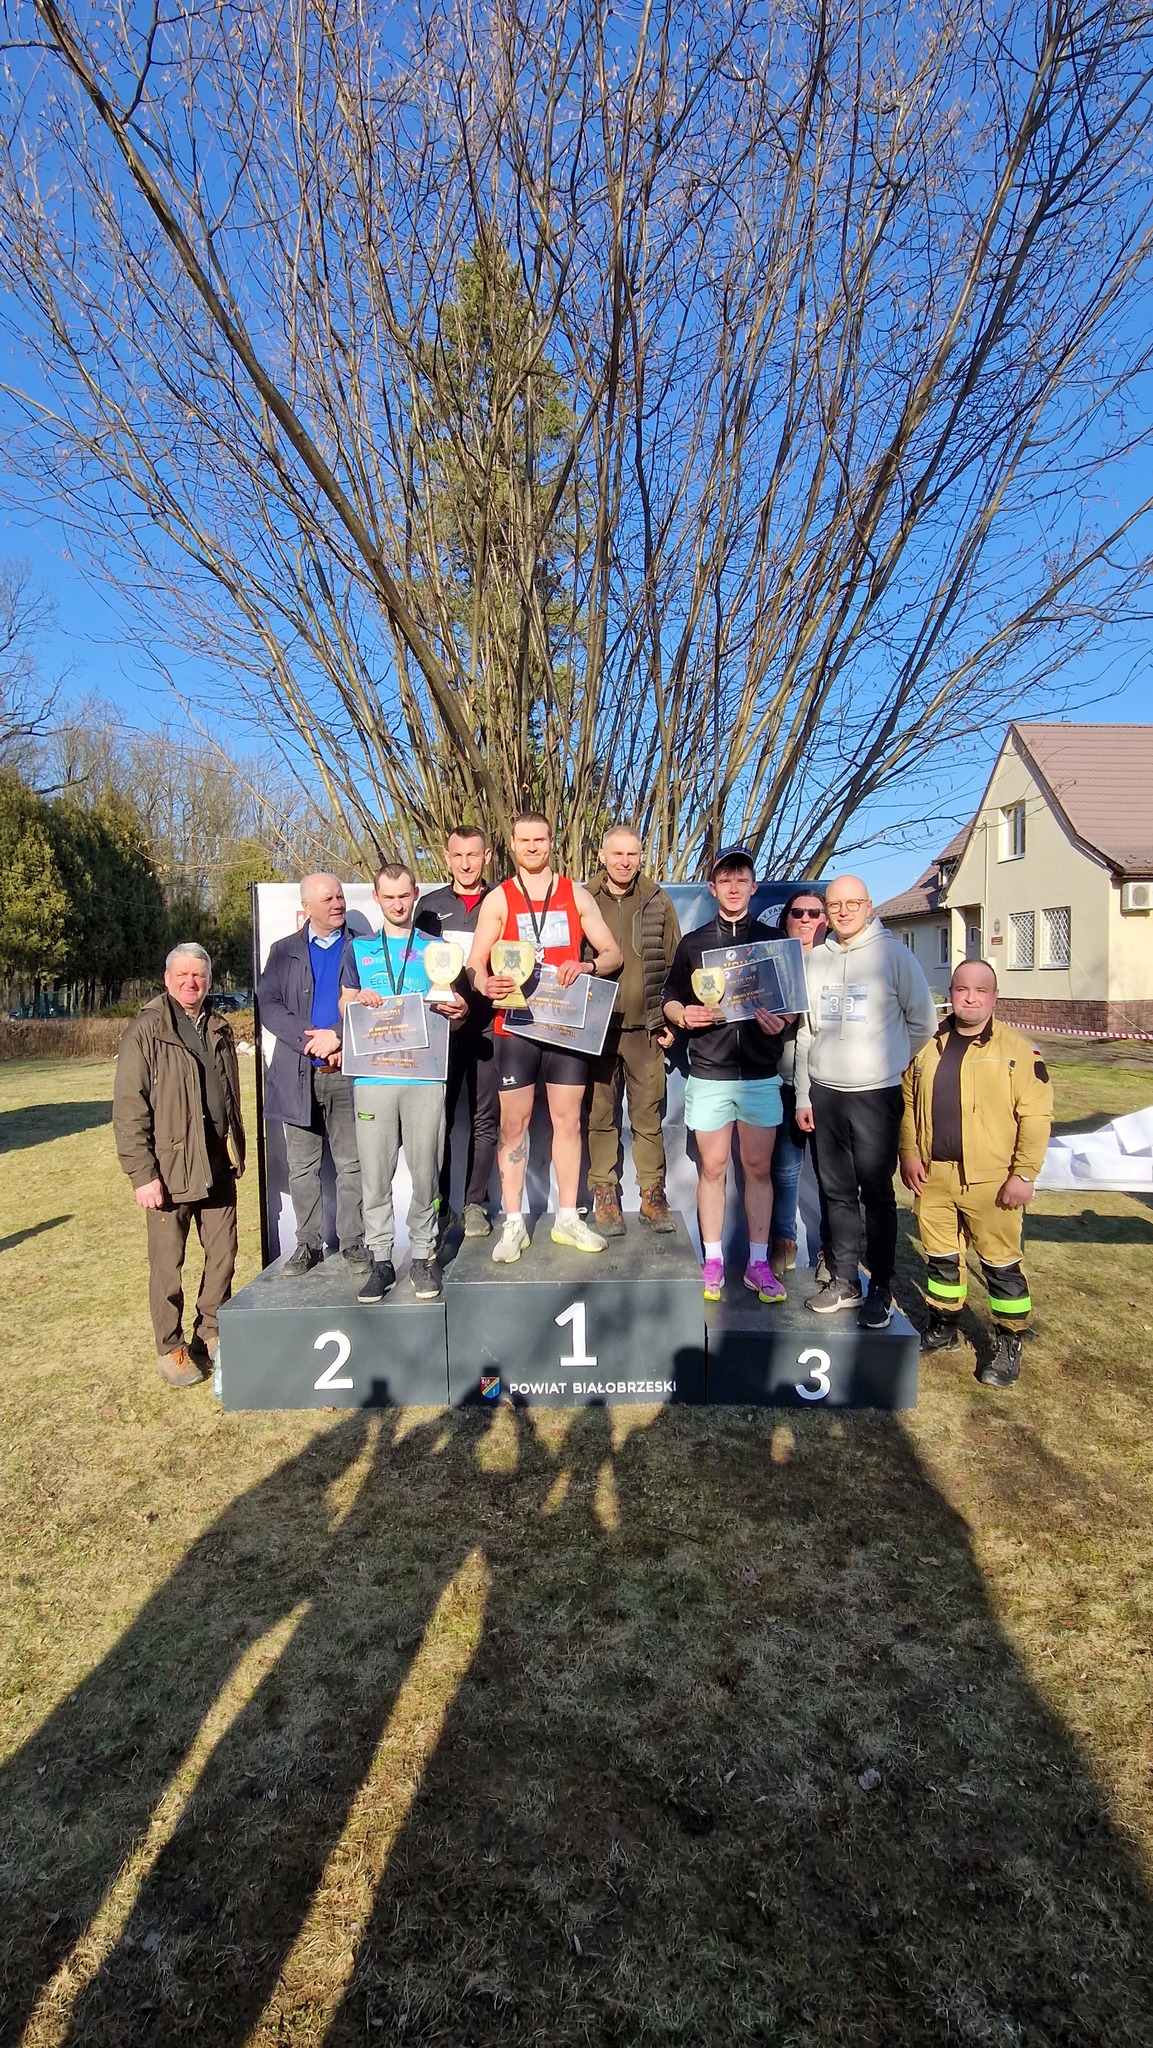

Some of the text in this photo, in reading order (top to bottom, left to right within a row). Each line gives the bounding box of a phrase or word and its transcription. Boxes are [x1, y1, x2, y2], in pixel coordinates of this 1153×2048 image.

[525, 922, 563, 942] 541
[313, 1330, 354, 1390] 2
[554, 1302, 598, 1367] 1
[509, 1380, 677, 1395] POWIAT BIAŁOBRZESKI
[795, 1348, 831, 1401] 3
